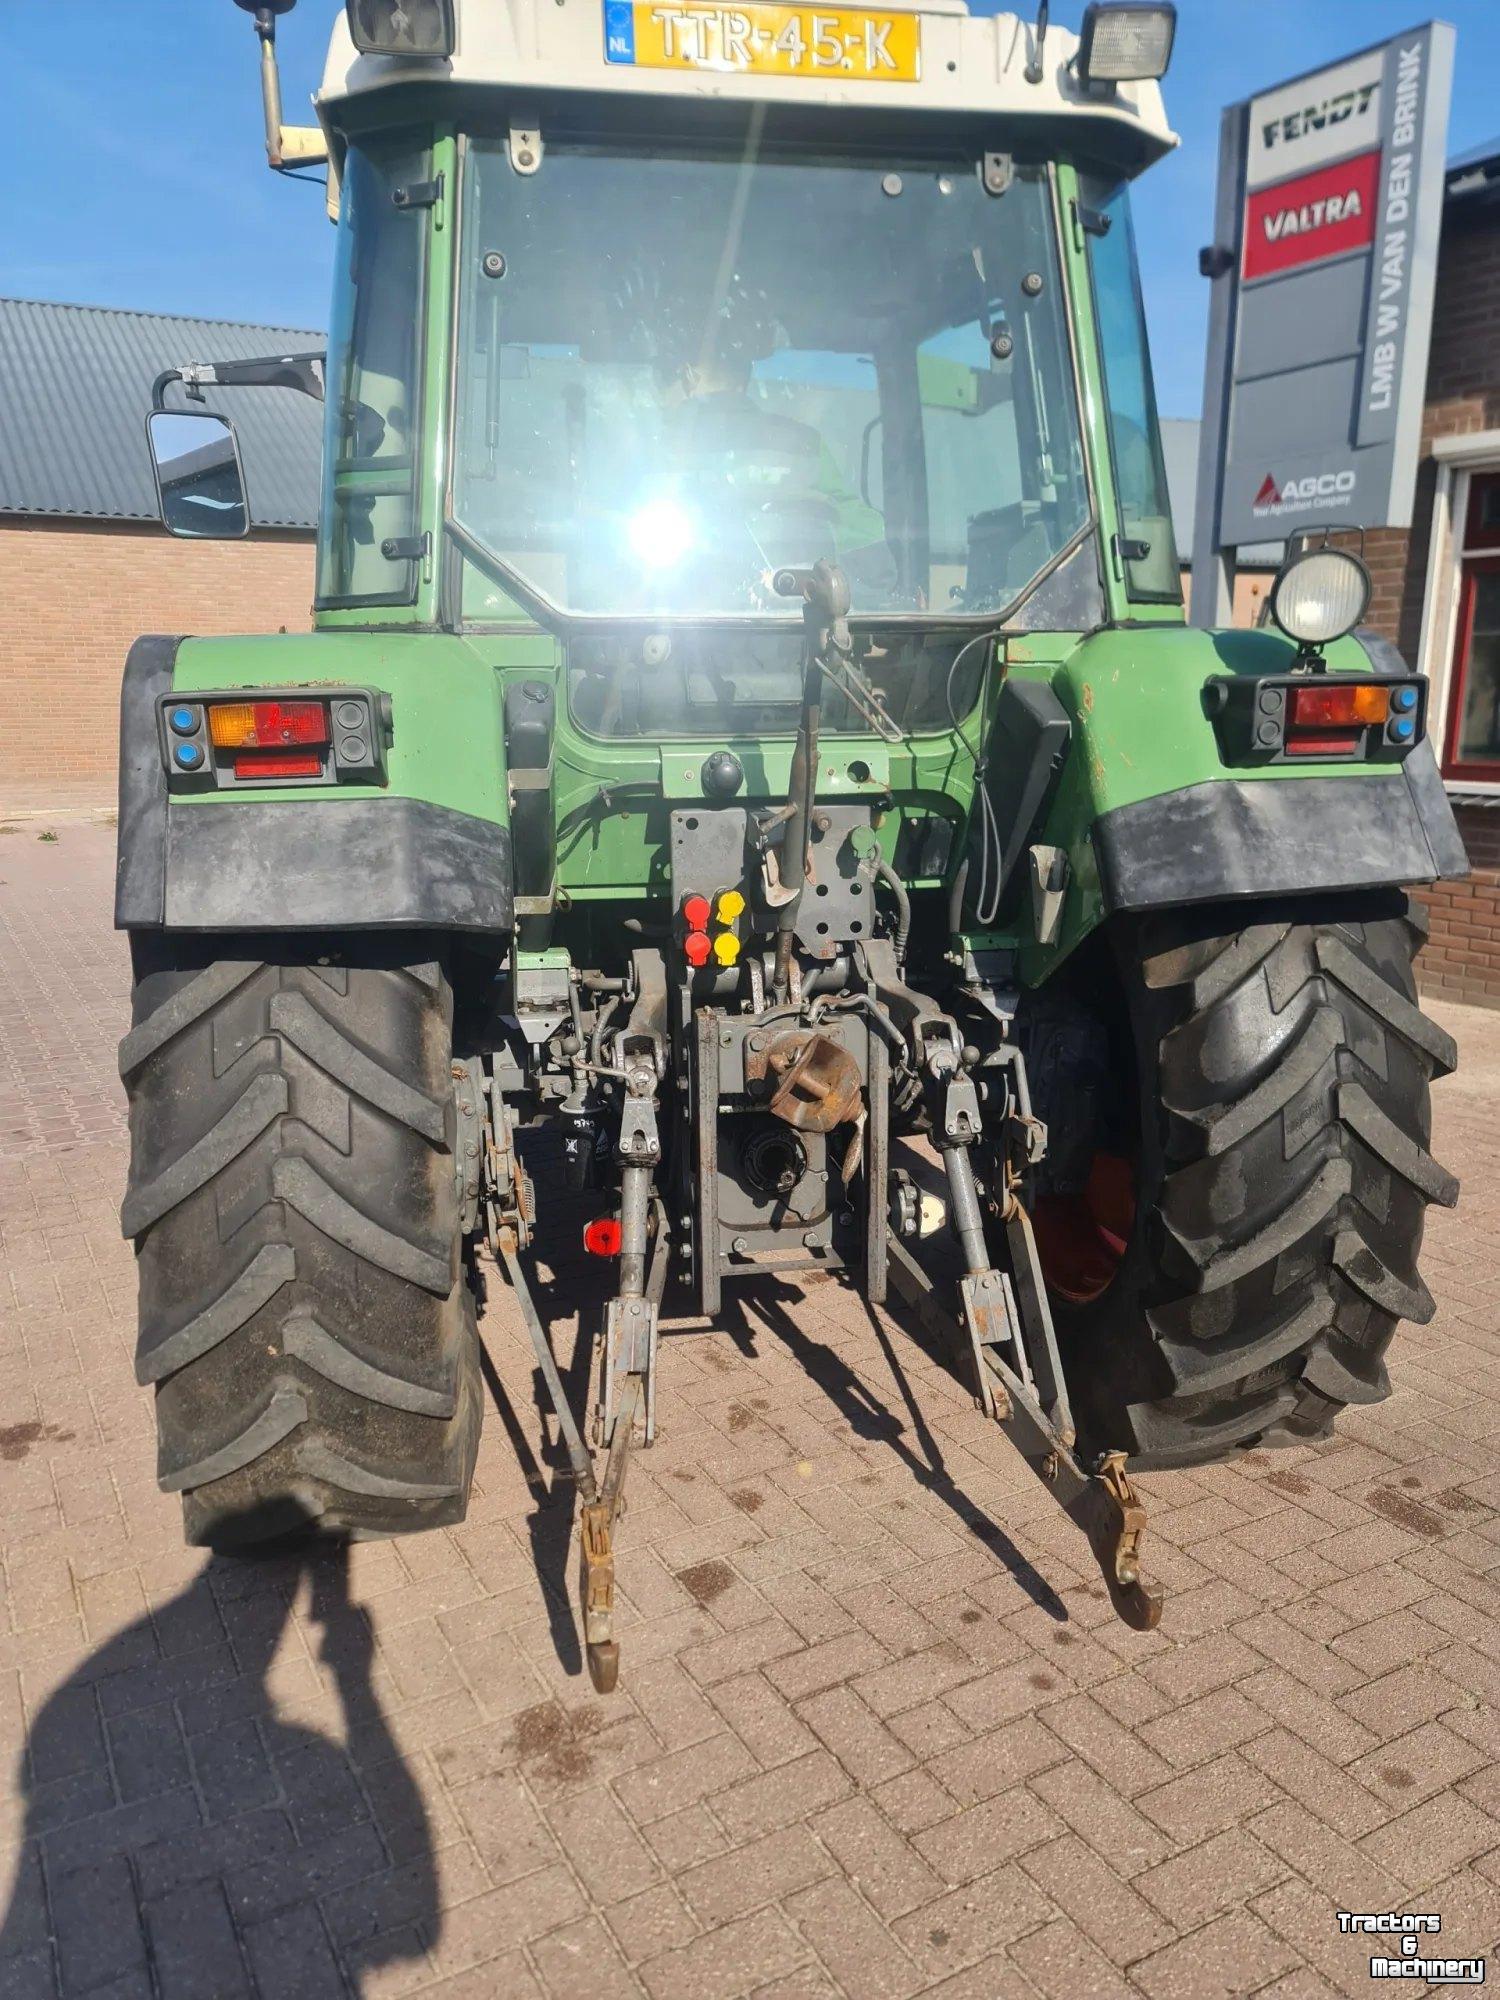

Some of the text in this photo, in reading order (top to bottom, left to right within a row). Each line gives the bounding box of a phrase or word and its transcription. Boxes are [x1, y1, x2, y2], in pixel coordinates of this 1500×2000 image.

[609, 36, 630, 54] NL
[651, 8, 897, 71] TTR-45-K
[1262, 80, 1381, 148] FENDT
[1263, 188, 1362, 243] VALTRA
[1369, 40, 1423, 411] LMB W VAN DEN BRINK
[1281, 470, 1356, 500] AGCO
